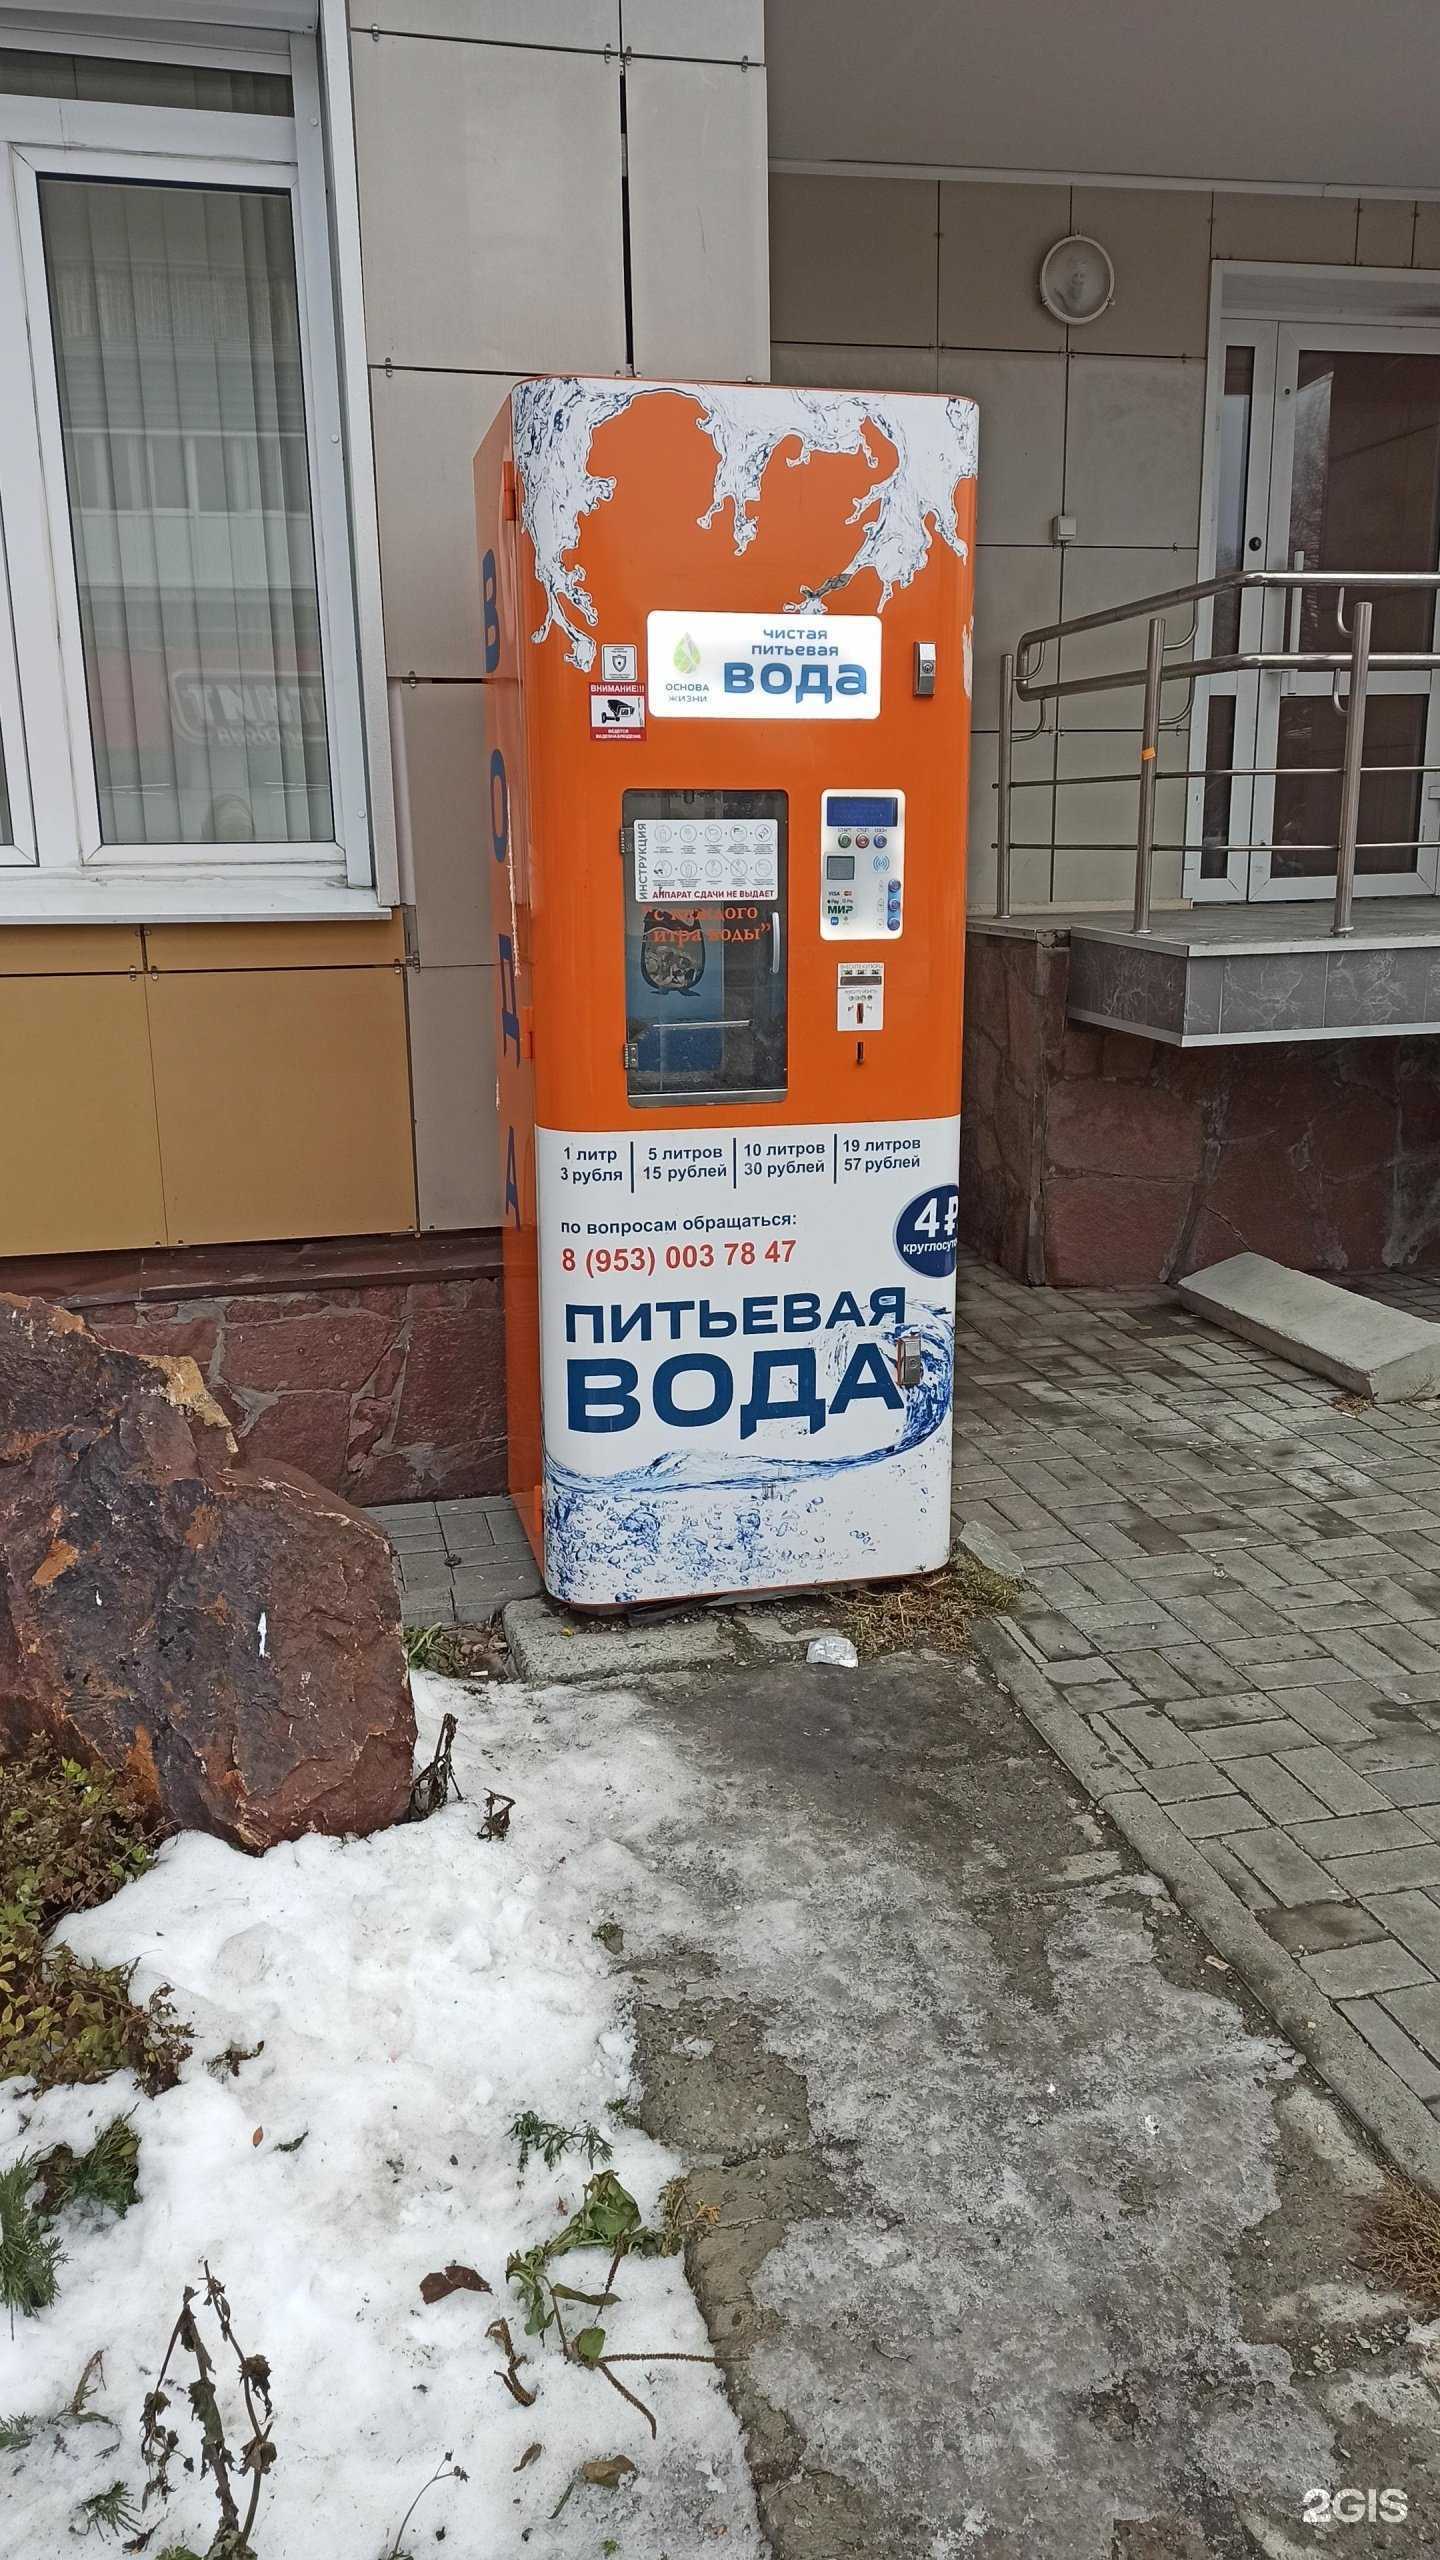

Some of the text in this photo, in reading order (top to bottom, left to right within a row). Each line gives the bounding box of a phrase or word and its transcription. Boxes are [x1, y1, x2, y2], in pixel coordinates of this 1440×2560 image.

[763, 628, 828, 641] чистая
[751, 644, 839, 657] питьевая
[665, 682, 710, 692] ОСНОВА
[637, 822, 649, 900] ИНСТРУКЦИЯ
[482, 548, 522, 1232] ВОДА
[652, 889, 775, 900] АППАРАТ СДАЧИ НЕ ВЫДАЕТ
[828, 905, 854, 915] МИР
[563, 1146, 618, 1163] 1 литр
[648, 1147, 723, 1162] 5 литров
[744, 1143, 825, 1158] 10 литров
[843, 1138, 921, 1153] 19 литров
[643, 1163, 727, 1182] 15 рублей
[744, 1160, 825, 1178] 30 рублей
[844, 1155, 920, 1173] 57 рублей
[560, 1167, 623, 1185] 3 рубля
[561, 1213, 797, 1237] по вопросам обращаться:
[562, 1239, 797, 1279] 8 (953) 003 78 47
[565, 1286, 906, 1343] ПИТЬЕВАЯ
[566, 1342, 905, 1440] ВОДА
